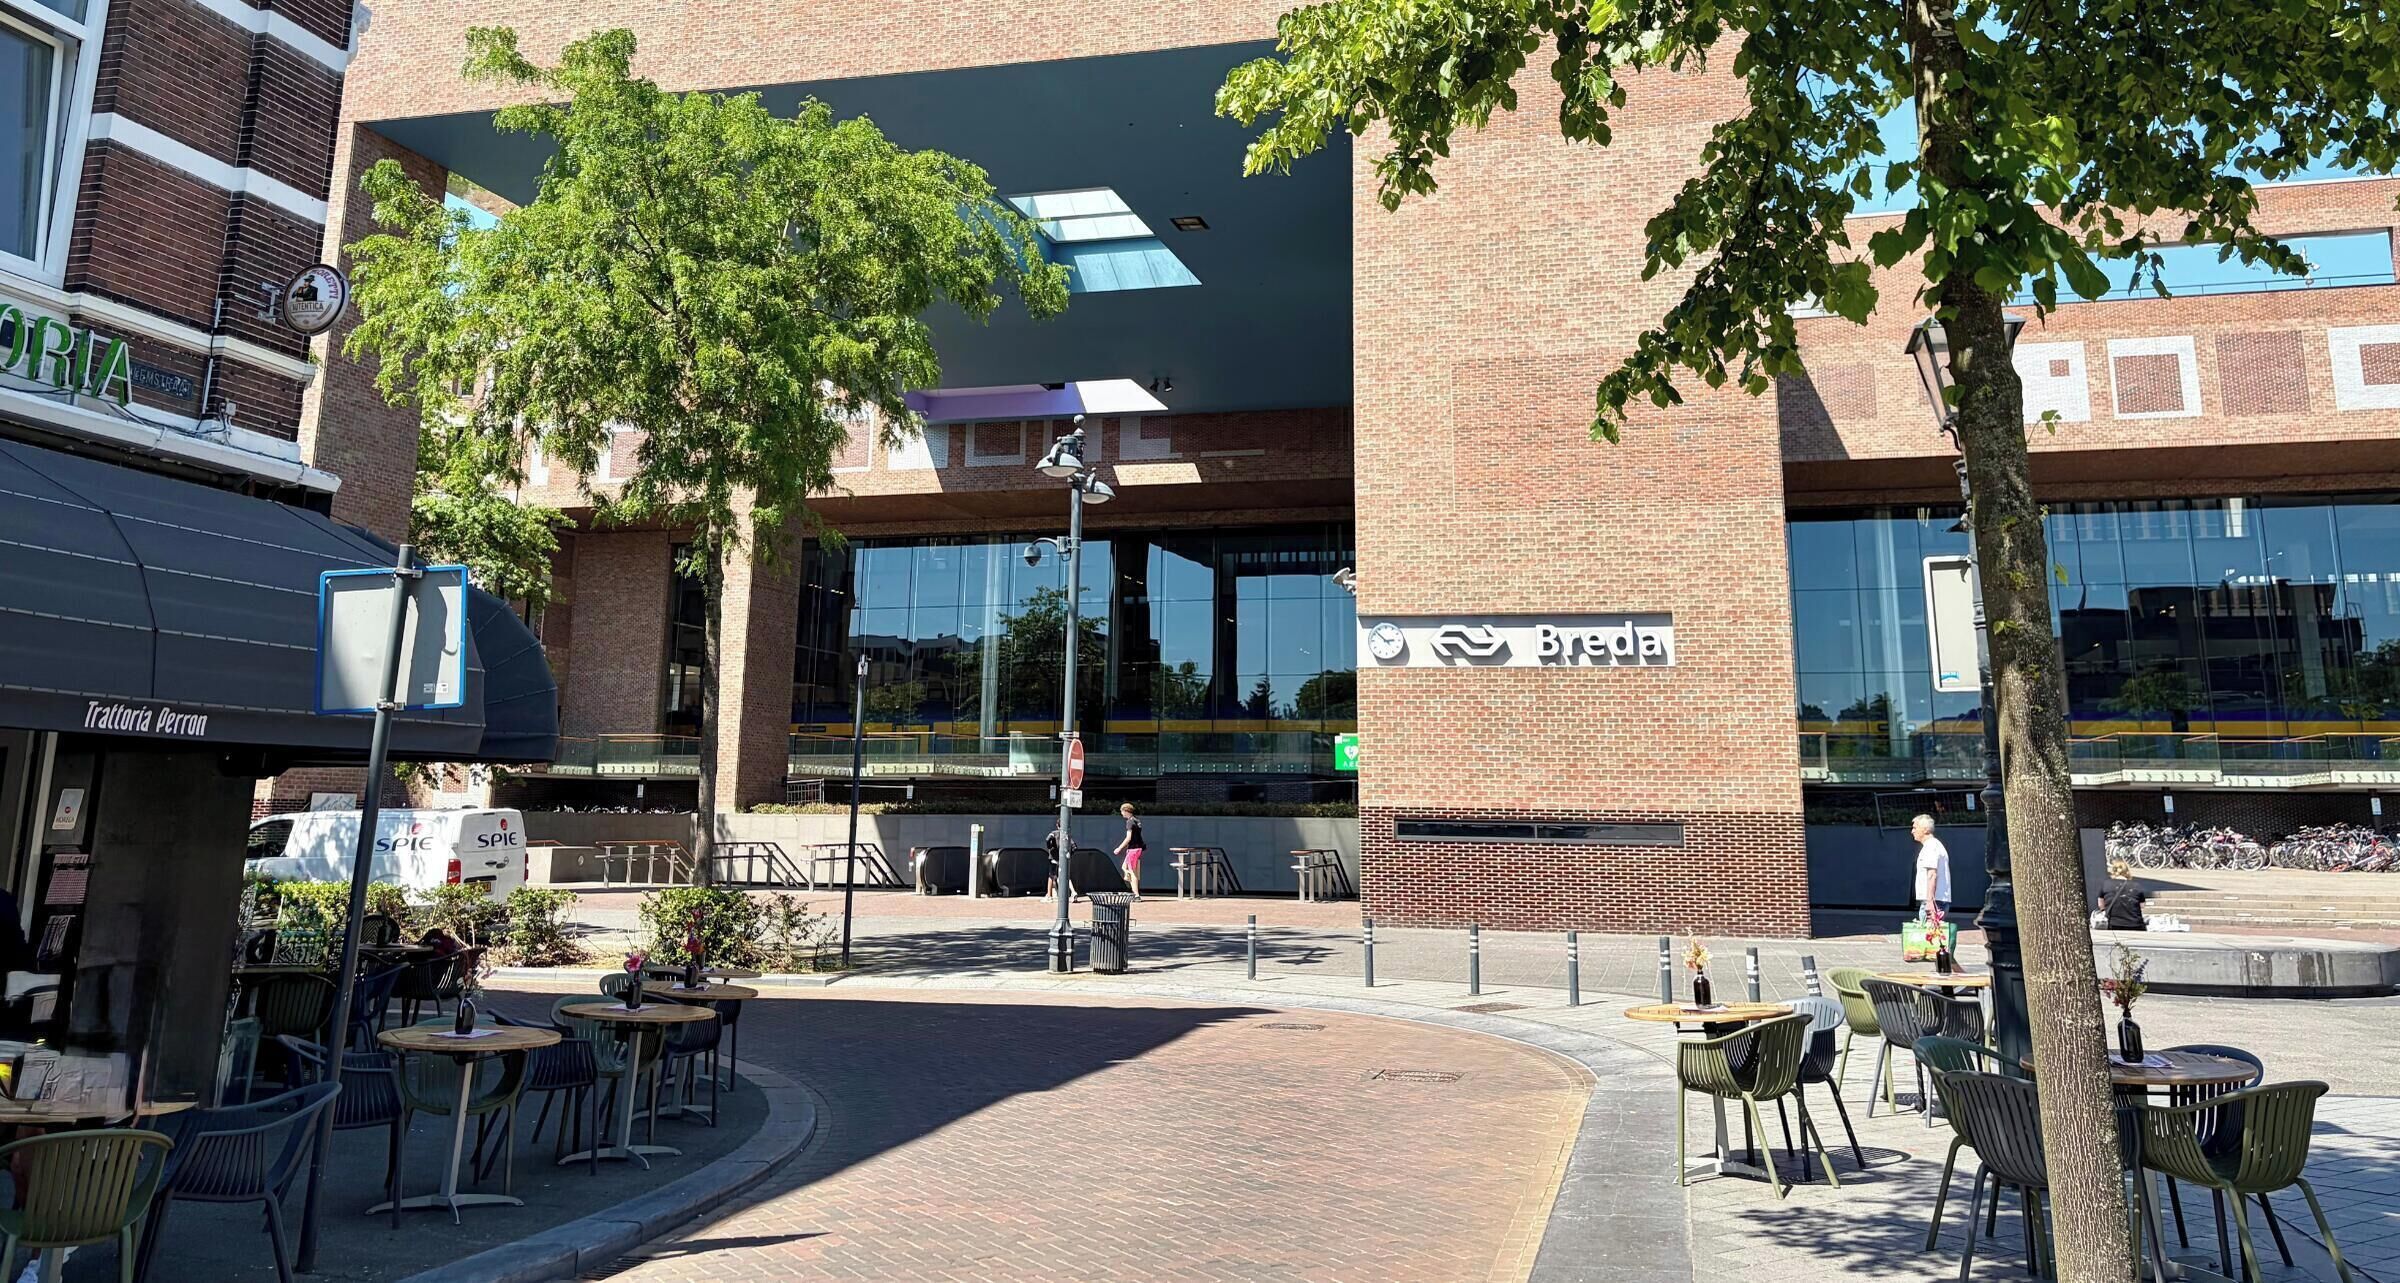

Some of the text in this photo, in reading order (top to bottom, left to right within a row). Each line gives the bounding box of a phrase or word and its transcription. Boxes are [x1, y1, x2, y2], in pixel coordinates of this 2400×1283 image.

[1535, 621, 1662, 657] Breda
[84, 701, 208, 736] Trattoria Perron
[374, 836, 434, 852] SPIE
[477, 831, 518, 848] SPIE
